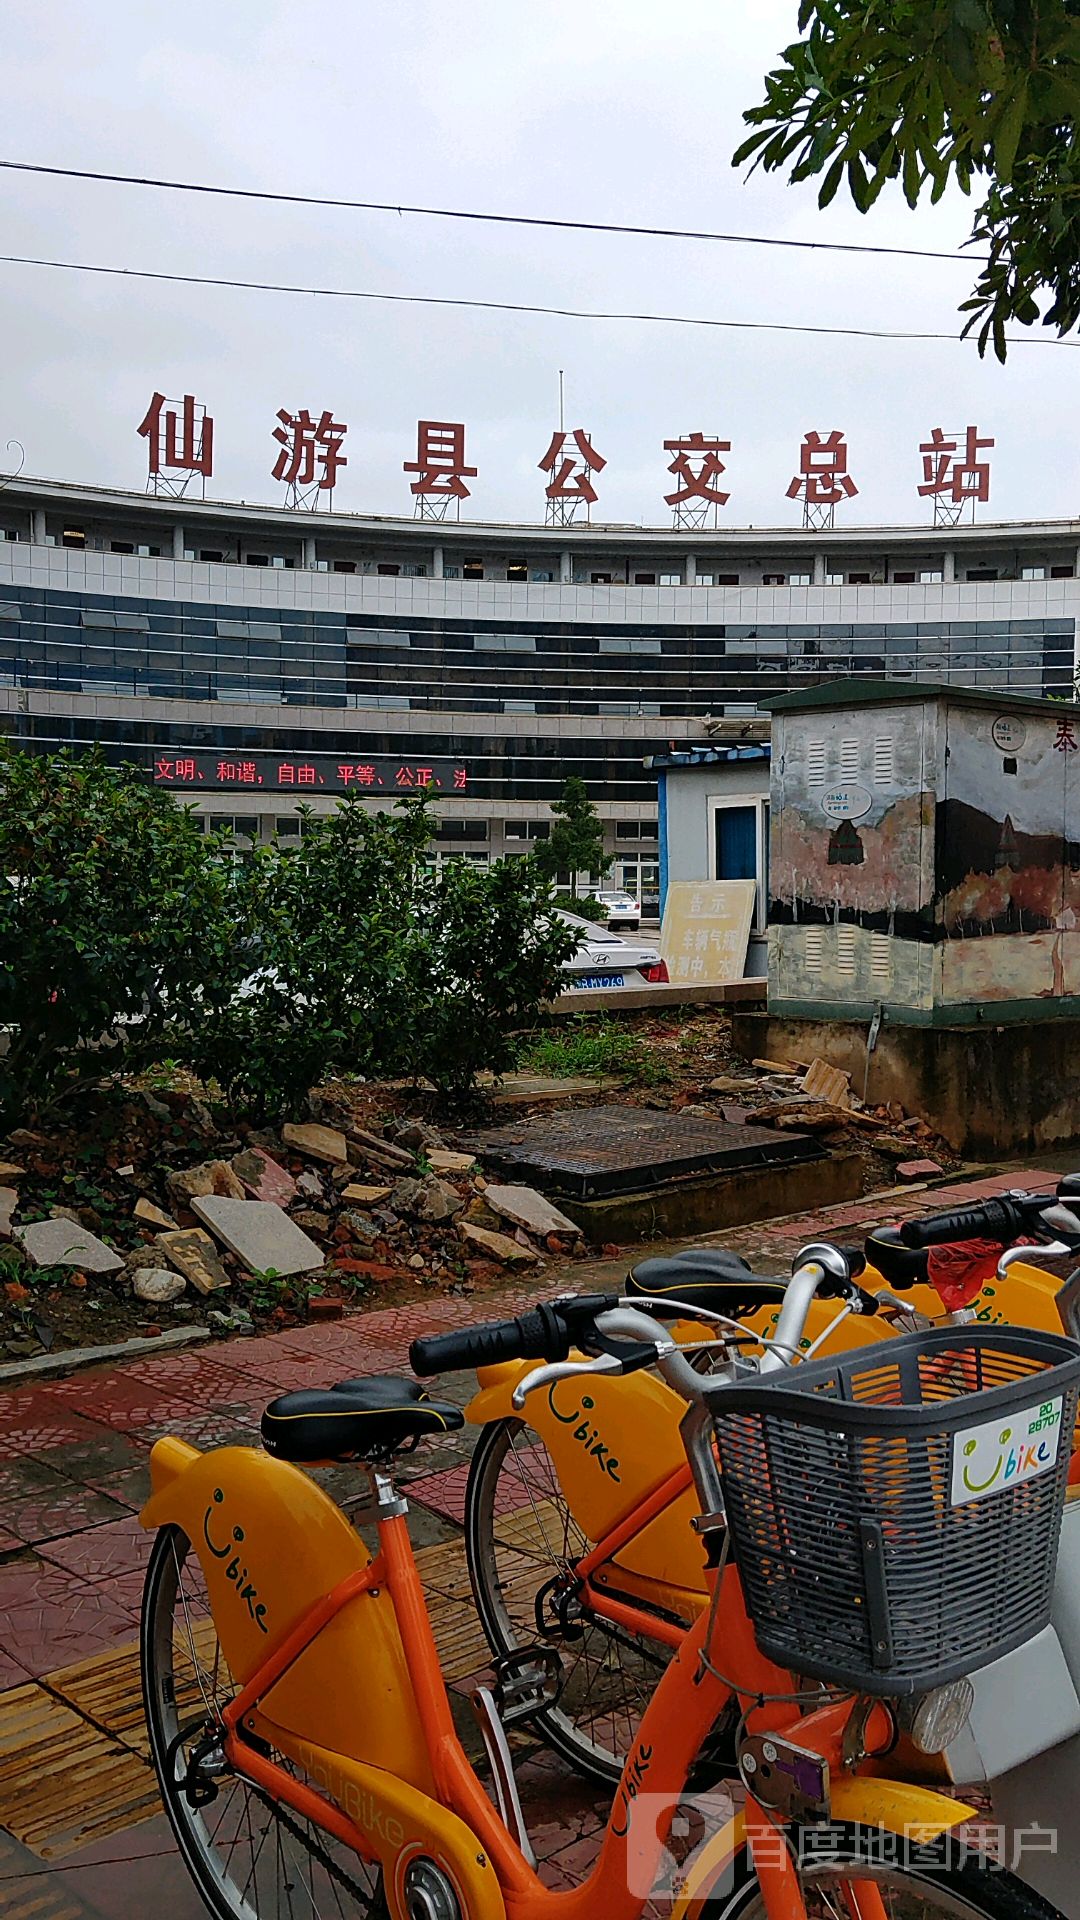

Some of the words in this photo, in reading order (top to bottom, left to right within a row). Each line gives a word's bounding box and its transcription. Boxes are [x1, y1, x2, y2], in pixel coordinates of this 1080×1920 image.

[137, 392, 995, 505] 仙游县公交总站
[1039, 1402, 1053, 1417] 20
[1028, 1410, 1060, 1435] 28707
